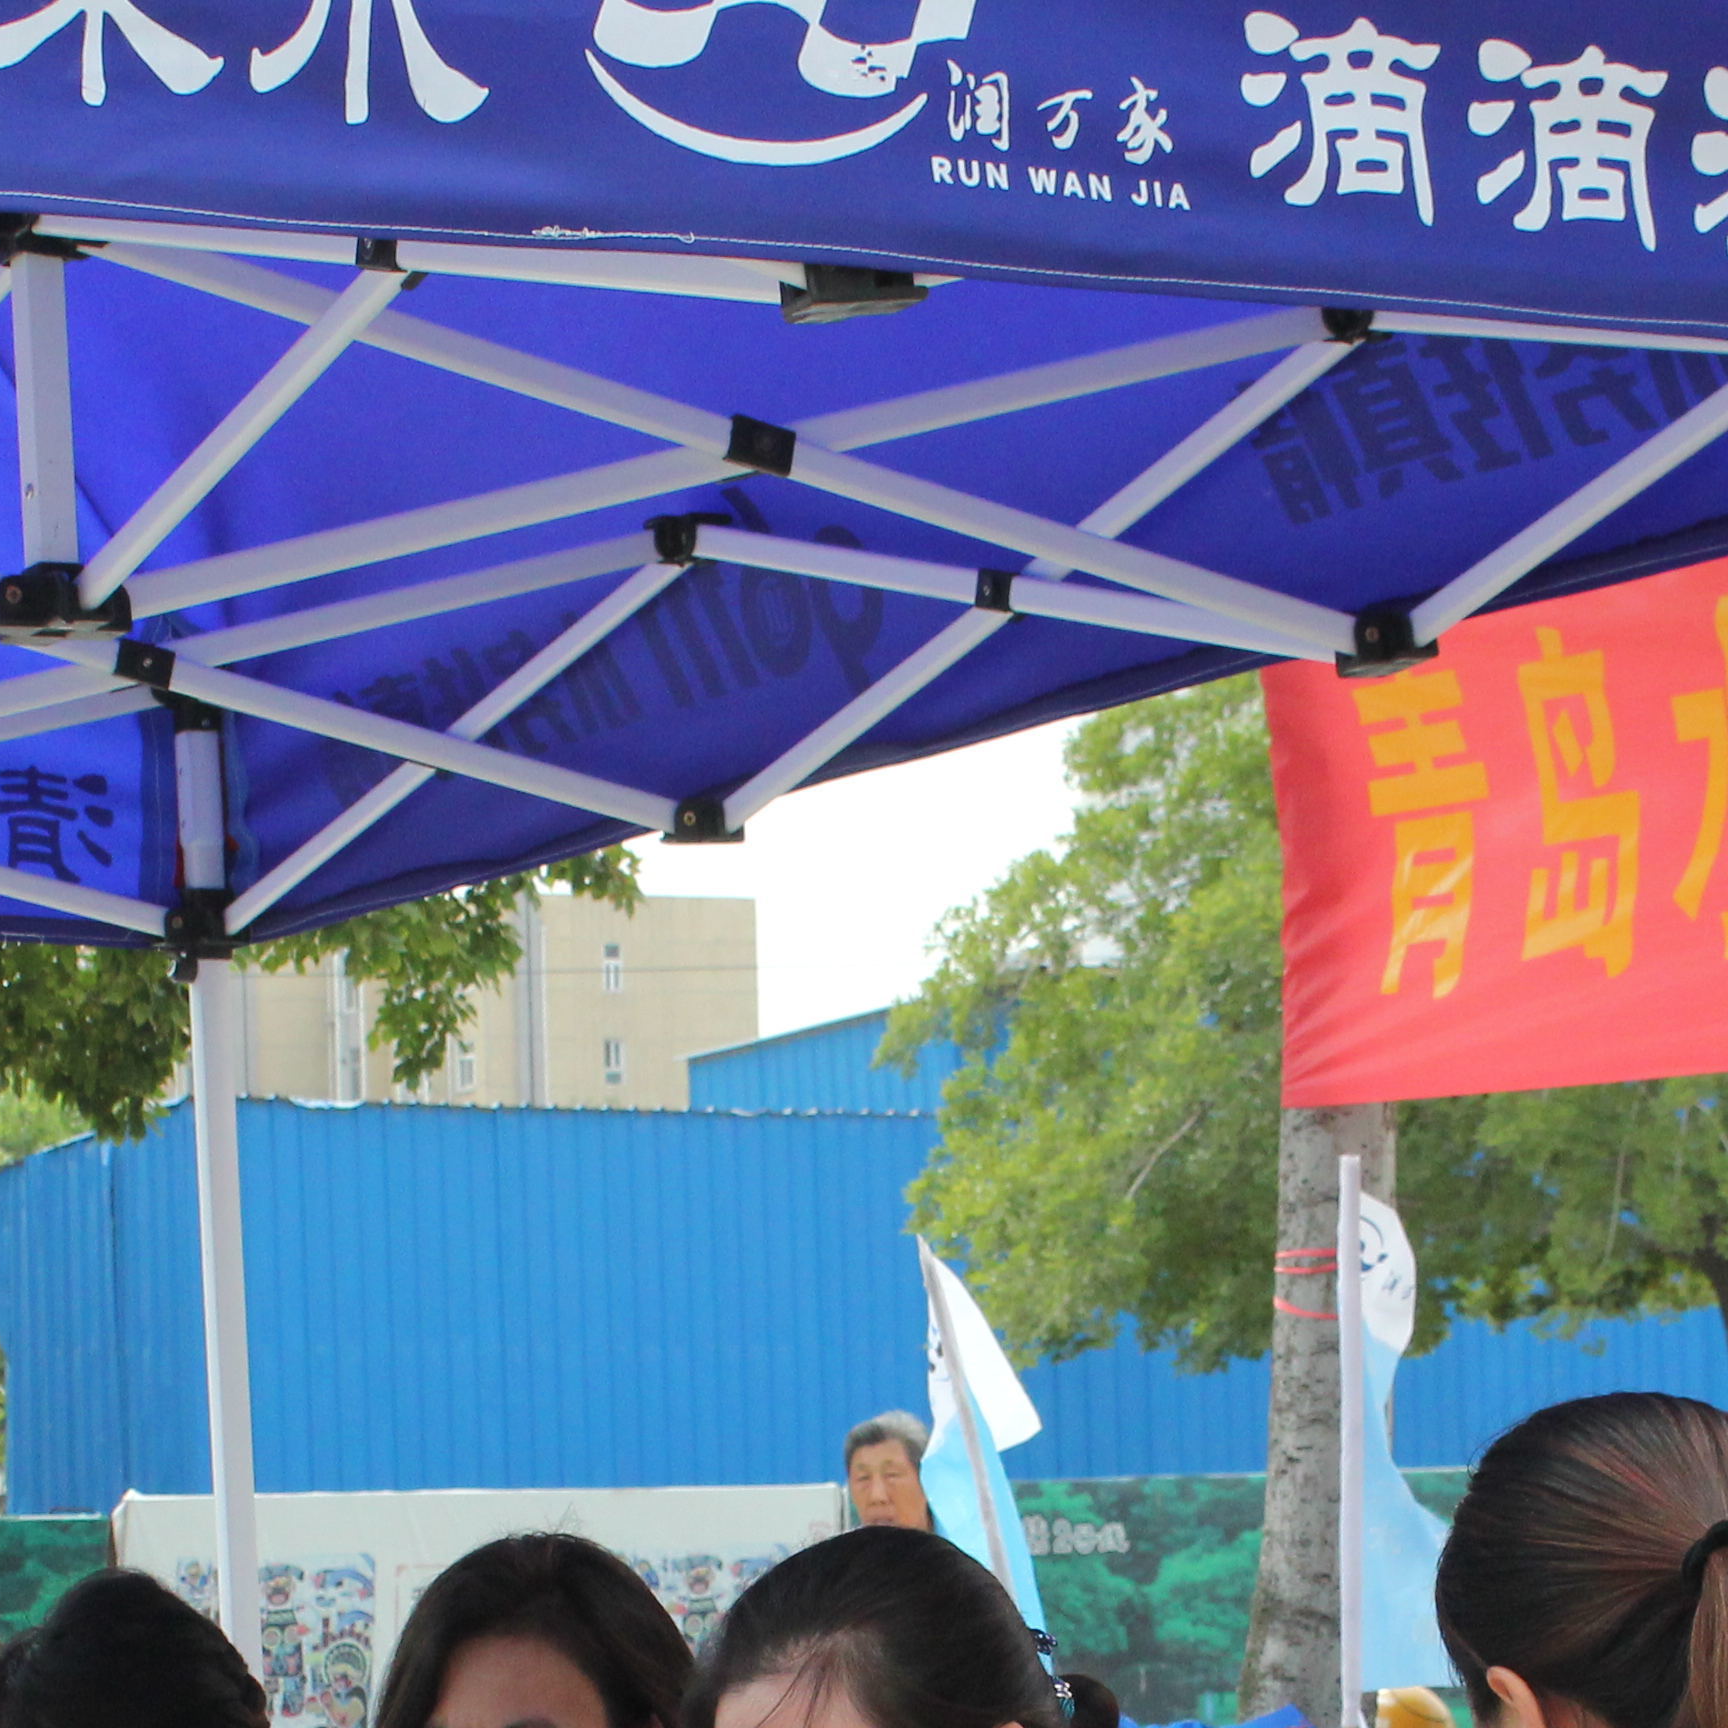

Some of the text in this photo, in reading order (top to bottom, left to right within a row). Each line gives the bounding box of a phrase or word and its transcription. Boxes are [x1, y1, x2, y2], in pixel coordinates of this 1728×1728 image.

[946, 59, 1174, 165] 润万家
[930, 155, 1192, 211] RUN WAN JIA
